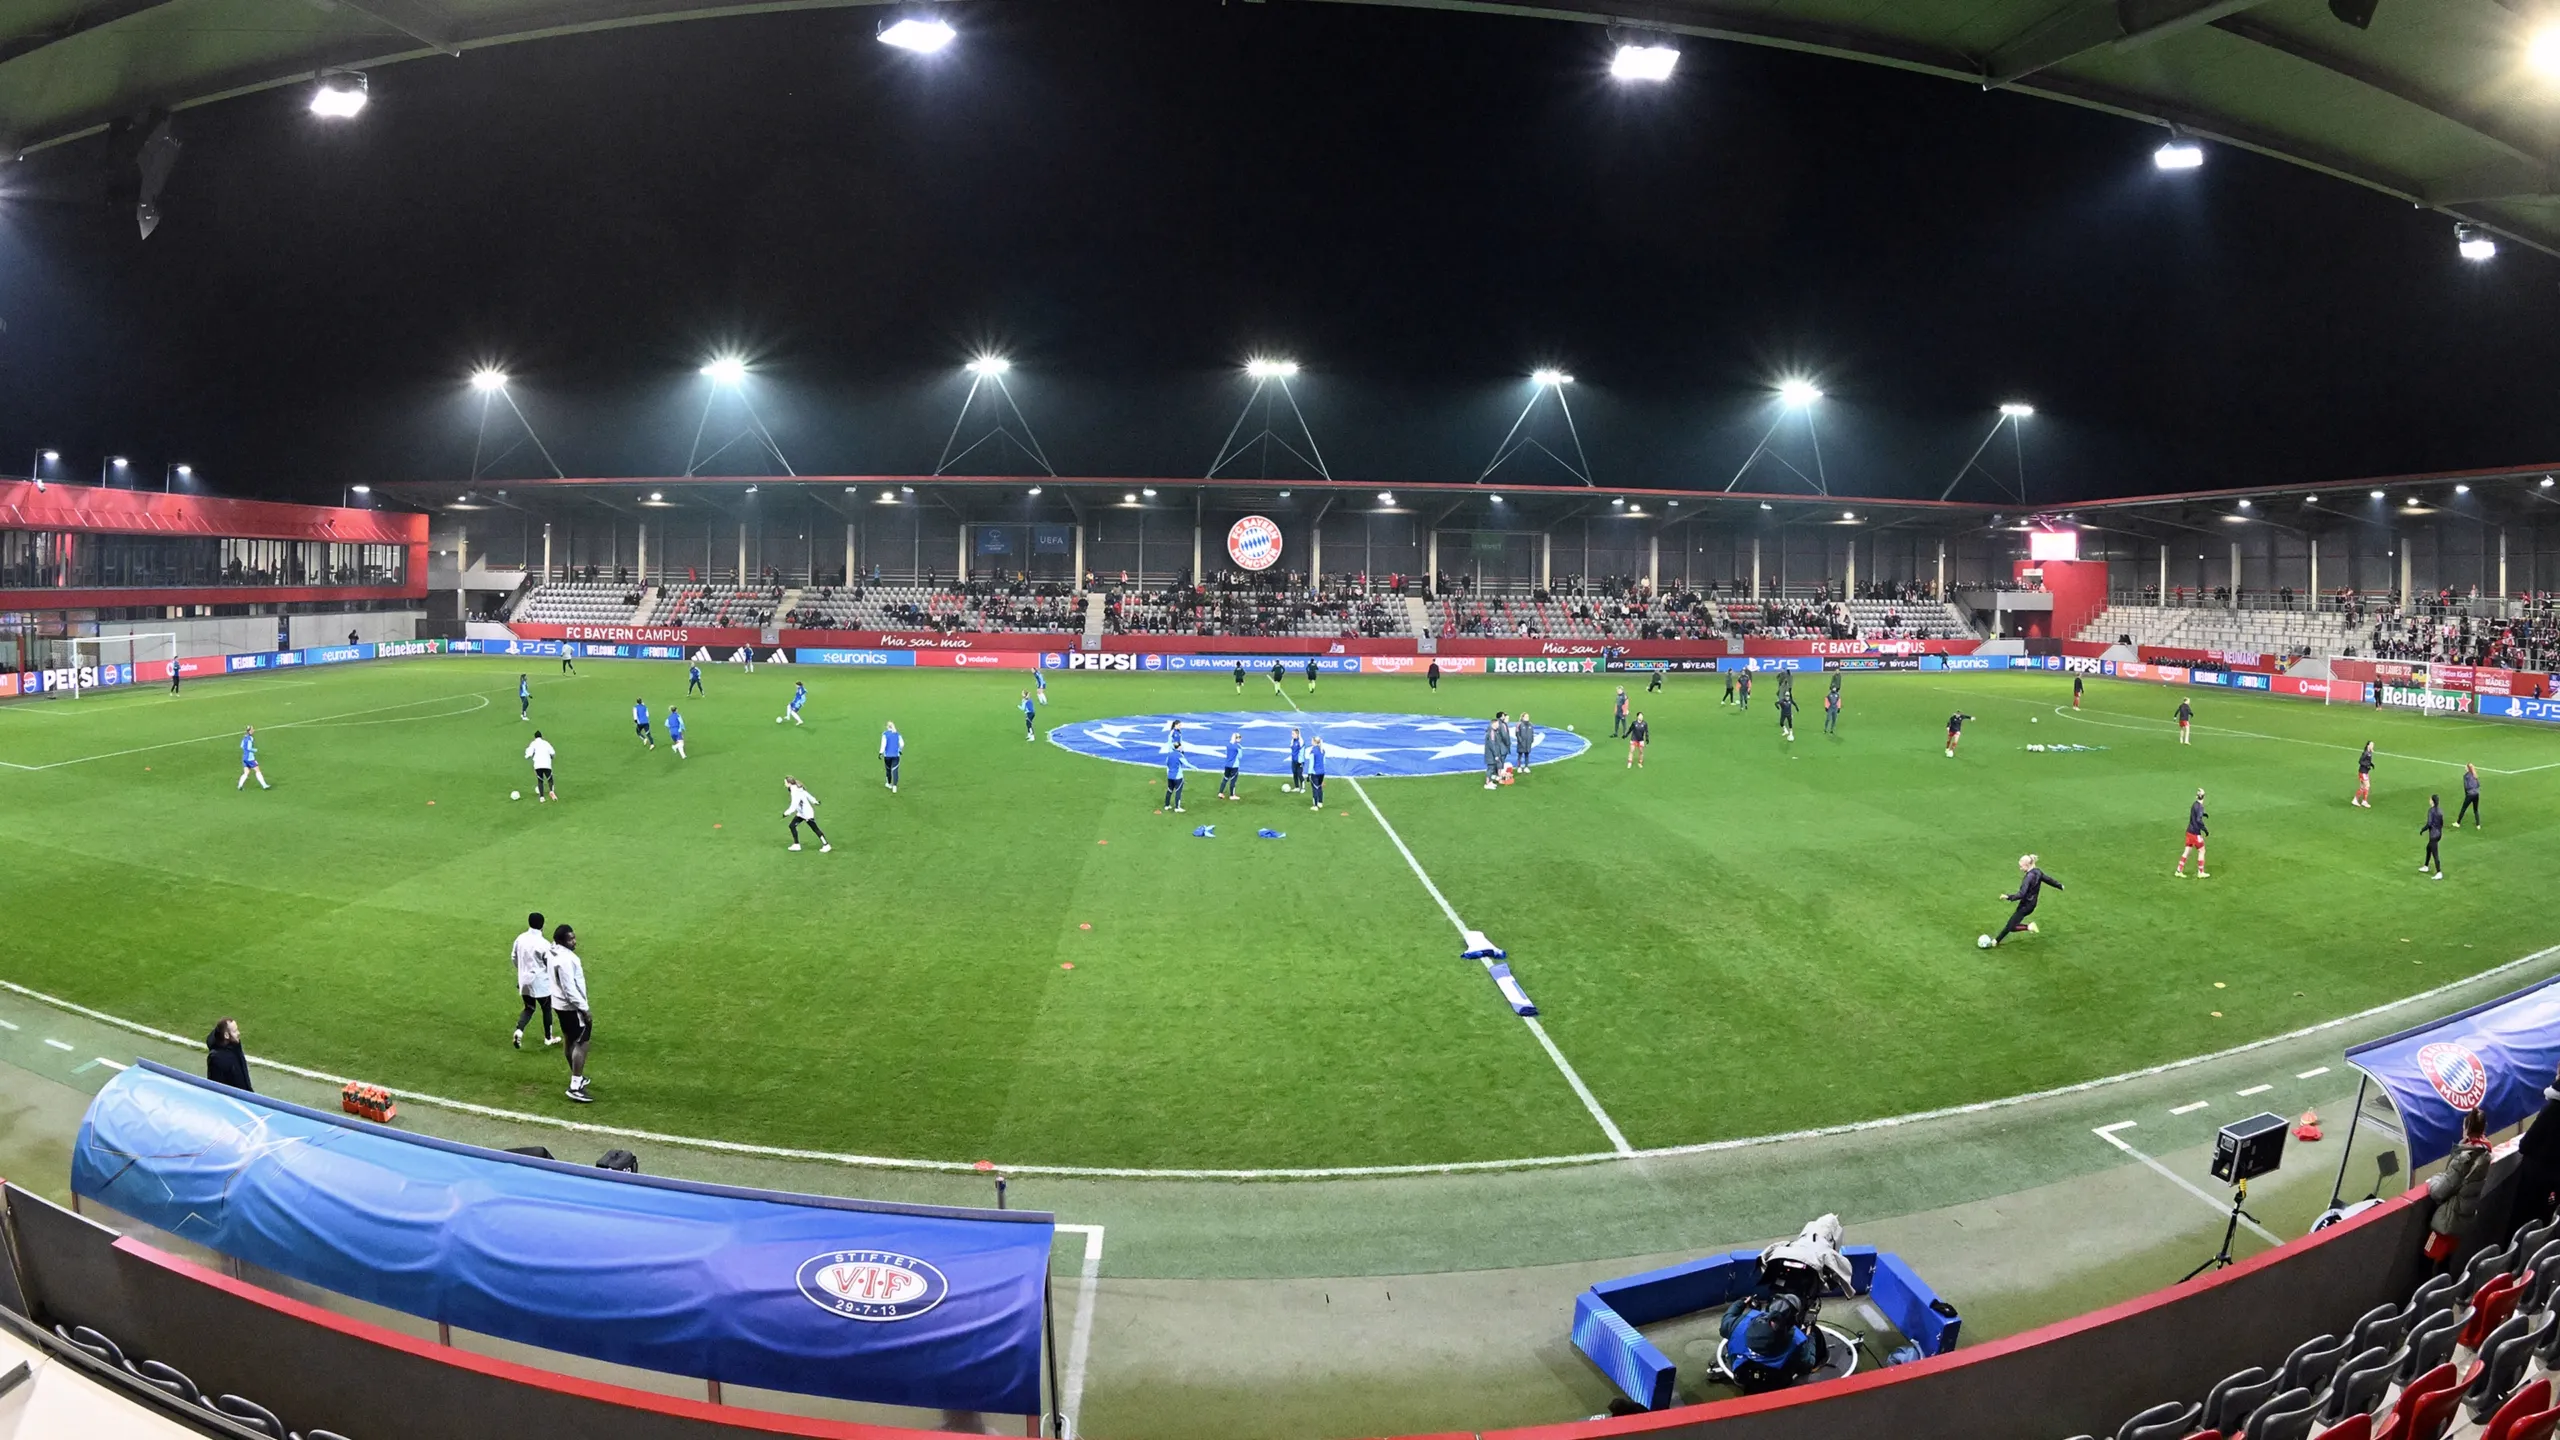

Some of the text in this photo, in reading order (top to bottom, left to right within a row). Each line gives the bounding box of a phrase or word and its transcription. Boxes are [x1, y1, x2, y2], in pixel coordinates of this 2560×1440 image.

[1231, 518, 1280, 539] FC BAYERN
[1040, 536, 1064, 544] UEFA
[566, 627, 688, 642] FC BAYERN CAMPUS
[523, 642, 556, 654] PS5
[881, 635, 973, 648] Mia san mia
[1542, 642, 1568, 654] Mia
[1571, 645, 1598, 654] san
[1811, 642, 1861, 654] FC BAYE
[327, 647, 359, 662] euronics
[378, 641, 425, 658] Heineken
[616, 646, 629, 656] ALL
[832, 650, 887, 664] euronics
[967, 655, 998, 664] vodafone
[1069, 653, 1137, 670] PEPSI
[1190, 659, 1211, 667] UEFA
[1372, 656, 1413, 667] amazon
[1435, 656, 1476, 667] amazon
[1948, 657, 1989, 669] euronics
[2223, 651, 2260, 666] NEUMARKT
[1494, 658, 1582, 673] Heineken
[1624, 660, 1669, 669] FOUNDATION
[1763, 659, 1799, 670] PS5
[1840, 660, 1878, 668] FOUNDATION
[2065, 657, 2100, 674] PEPSI
[2376, 664, 2384, 674] RED
[2386, 666, 2402, 675] LADIES
[42, 666, 99, 692] PEPSI
[2474, 685, 2510, 694] SUPPORTERS
[2382, 687, 2455, 711] Heineken
[2526, 701, 2560, 718] PS5
[2440, 1068, 2484, 1107] MÜNCHEN
[834, 1253, 918, 1270] STIFTET
[835, 1299, 897, 1316] 29-7-13
